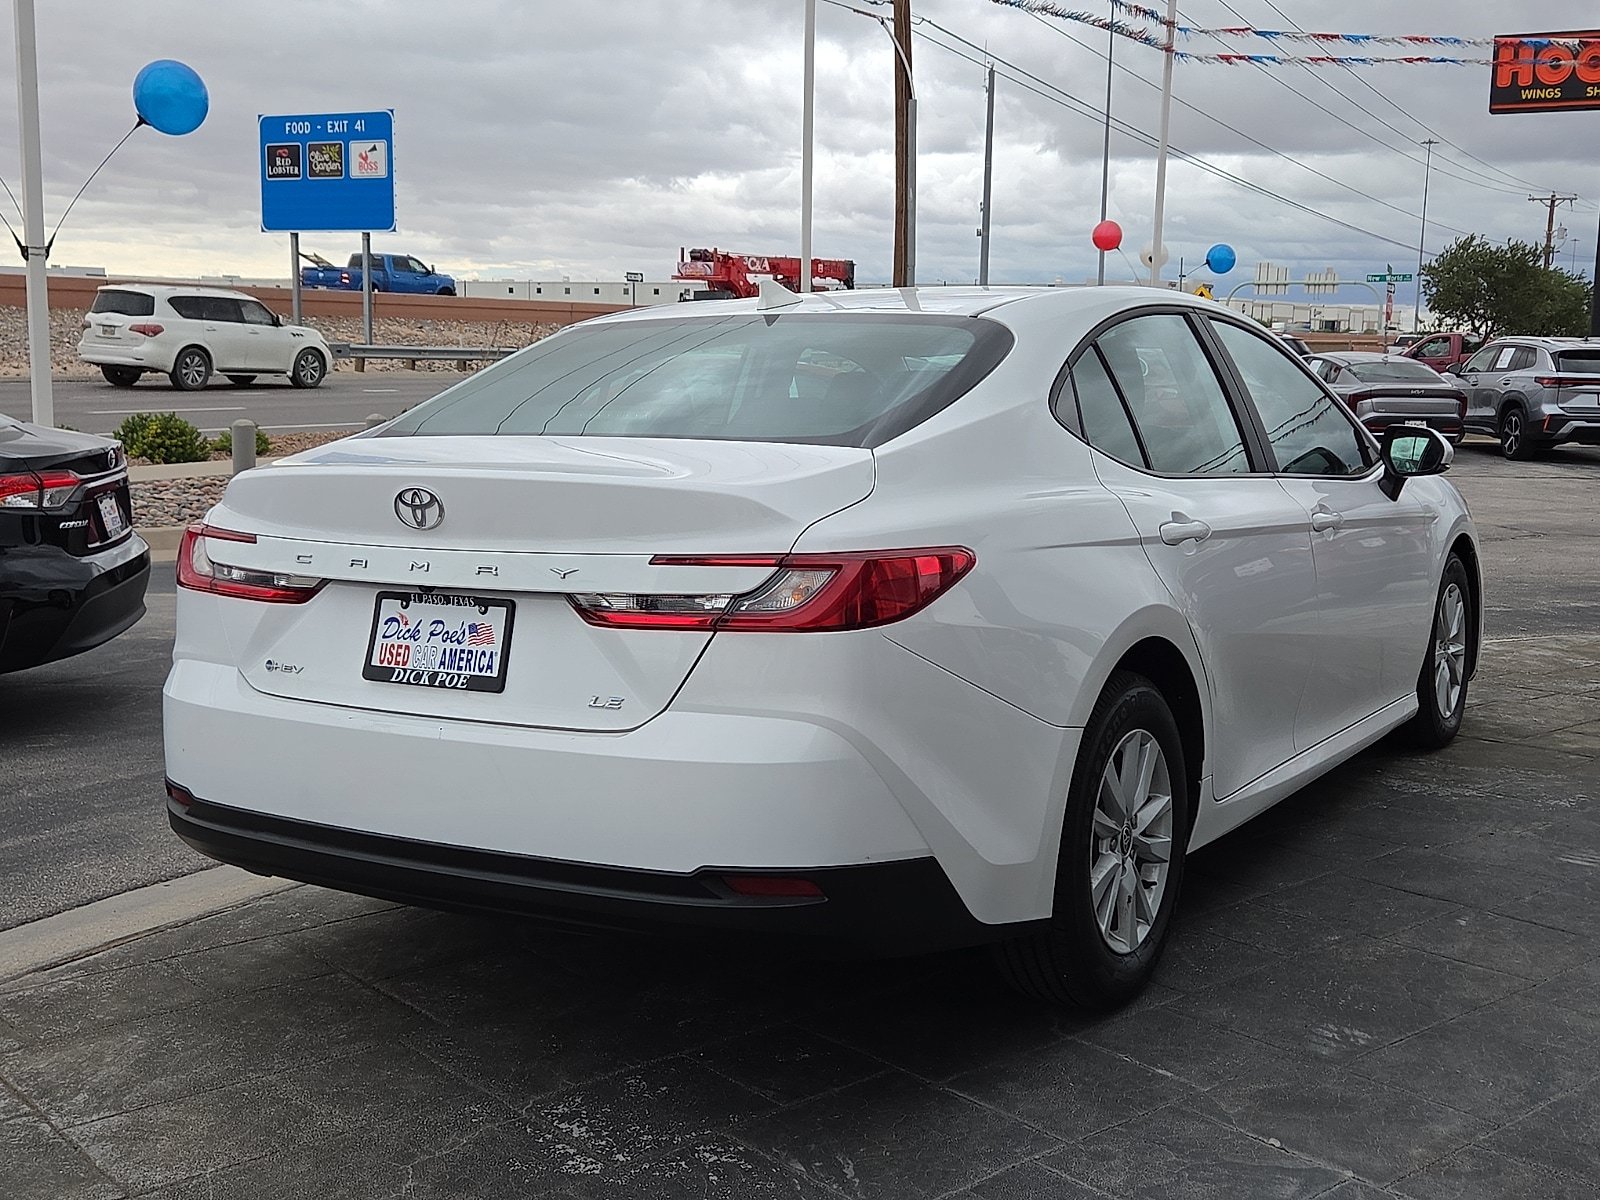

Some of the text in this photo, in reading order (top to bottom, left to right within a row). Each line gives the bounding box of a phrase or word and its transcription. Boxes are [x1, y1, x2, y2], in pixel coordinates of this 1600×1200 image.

[1521, 88, 1562, 99] WINGS
[285, 121, 311, 134] FOOD
[327, 120, 348, 133] EXIT
[354, 119, 365, 132] 41
[275, 157, 291, 167] RED
[309, 150, 331, 162] Olive
[268, 165, 299, 176] LOBSTER
[312, 160, 341, 173] Garden
[358, 160, 379, 172] BOSS
[410, 593, 475, 607] EL PASO, TEXAS
[382, 616, 467, 645] Dick Poe's
[378, 643, 494, 674] USED CAR AMERICA
[390, 668, 470, 689] DICK POE
[588, 695, 625, 710] LE
